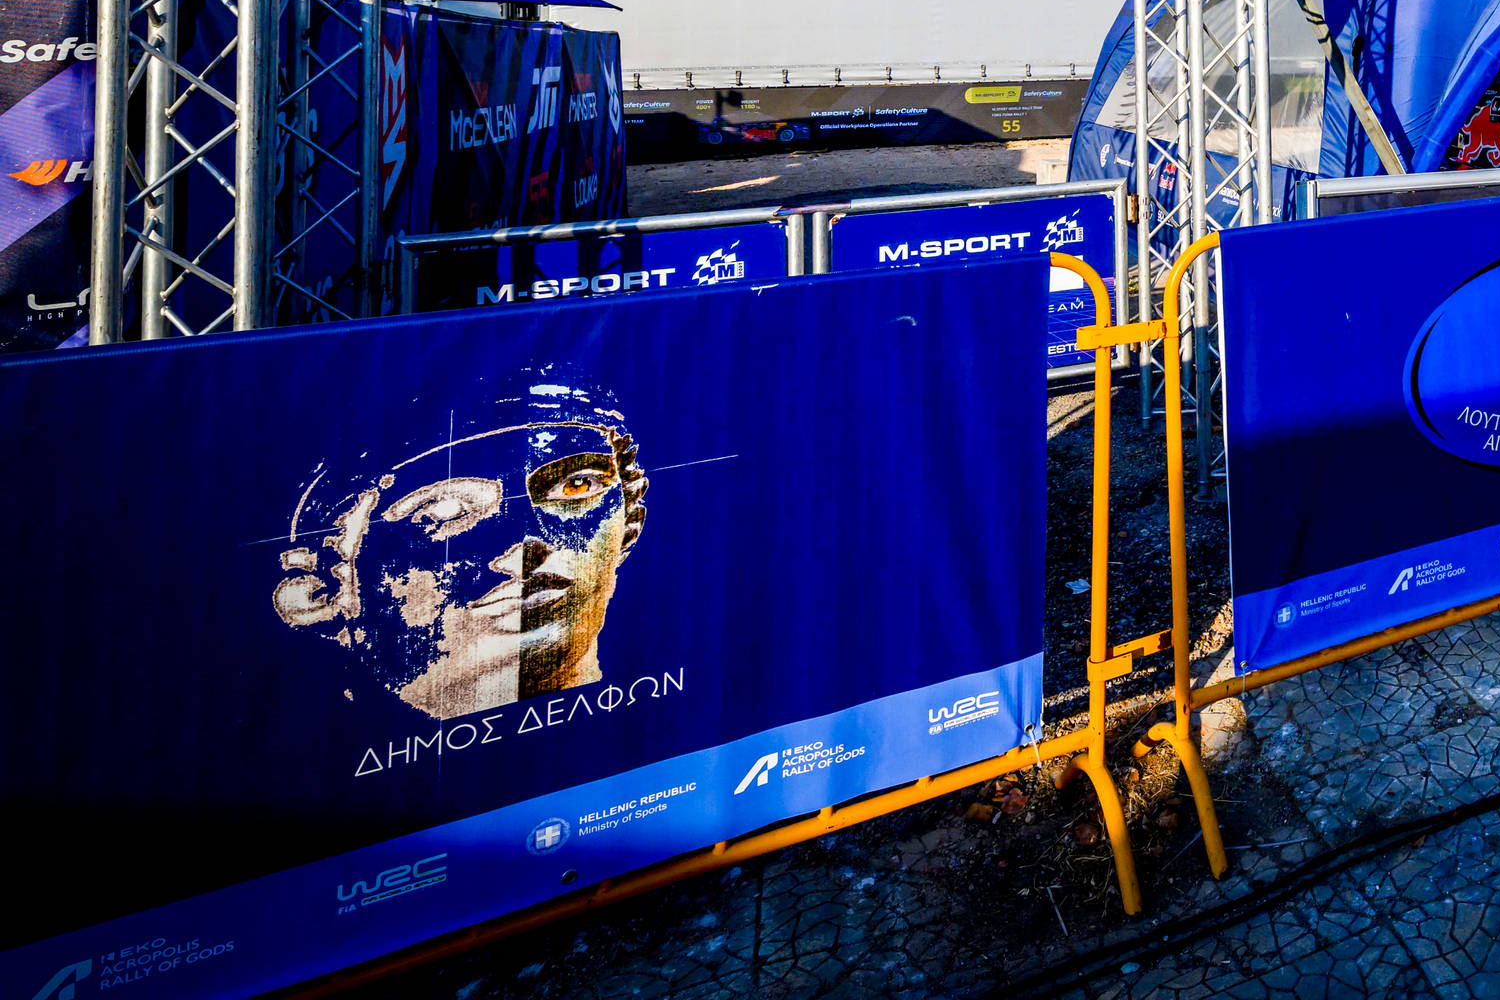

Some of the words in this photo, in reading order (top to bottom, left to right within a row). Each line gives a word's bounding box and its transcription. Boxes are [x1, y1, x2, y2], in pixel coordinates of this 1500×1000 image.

[875, 107, 928, 116] SafetyCulture
[1002, 120, 1021, 132] 55
[879, 232, 1031, 263] M-SPORT
[476, 267, 676, 305] M-SPORT
[1048, 301, 1084, 313] EAM
[1415, 562, 1453, 579] ACROPOLIS
[1416, 576, 1436, 587] RALLY
[1447, 566, 1466, 578] GODS
[1421, 560, 1440, 570] EKO
[1300, 594, 1333, 609] HELLENIC
[1334, 583, 1367, 601] REPUBLIC
[929, 690, 1000, 723] WRC
[354, 714, 503, 777] ΔΗΜΟΣ
[517, 667, 684, 734] ΔΕΛΦΩΝ
[782, 744, 846, 767] ACROPOLIS
[793, 741, 824, 755] EKO
[782, 762, 814, 778] RALLY
[817, 757, 832, 769] OF
[835, 746, 866, 764] GODS
[578, 797, 637, 825] HELLENIC
[640, 782, 698, 808] REPUBLIC
[578, 819, 617, 838] Ministry
[634, 802, 668, 823] Sports
[337, 853, 448, 901] WRC
[338, 904, 357, 915] FIA
[100, 938, 201, 977] ACROPOLIS
[120, 937, 167, 958] EKO
[100, 964, 152, 991] RALLY
[157, 957, 183, 974] OF
[186, 940, 235, 965] GODS
